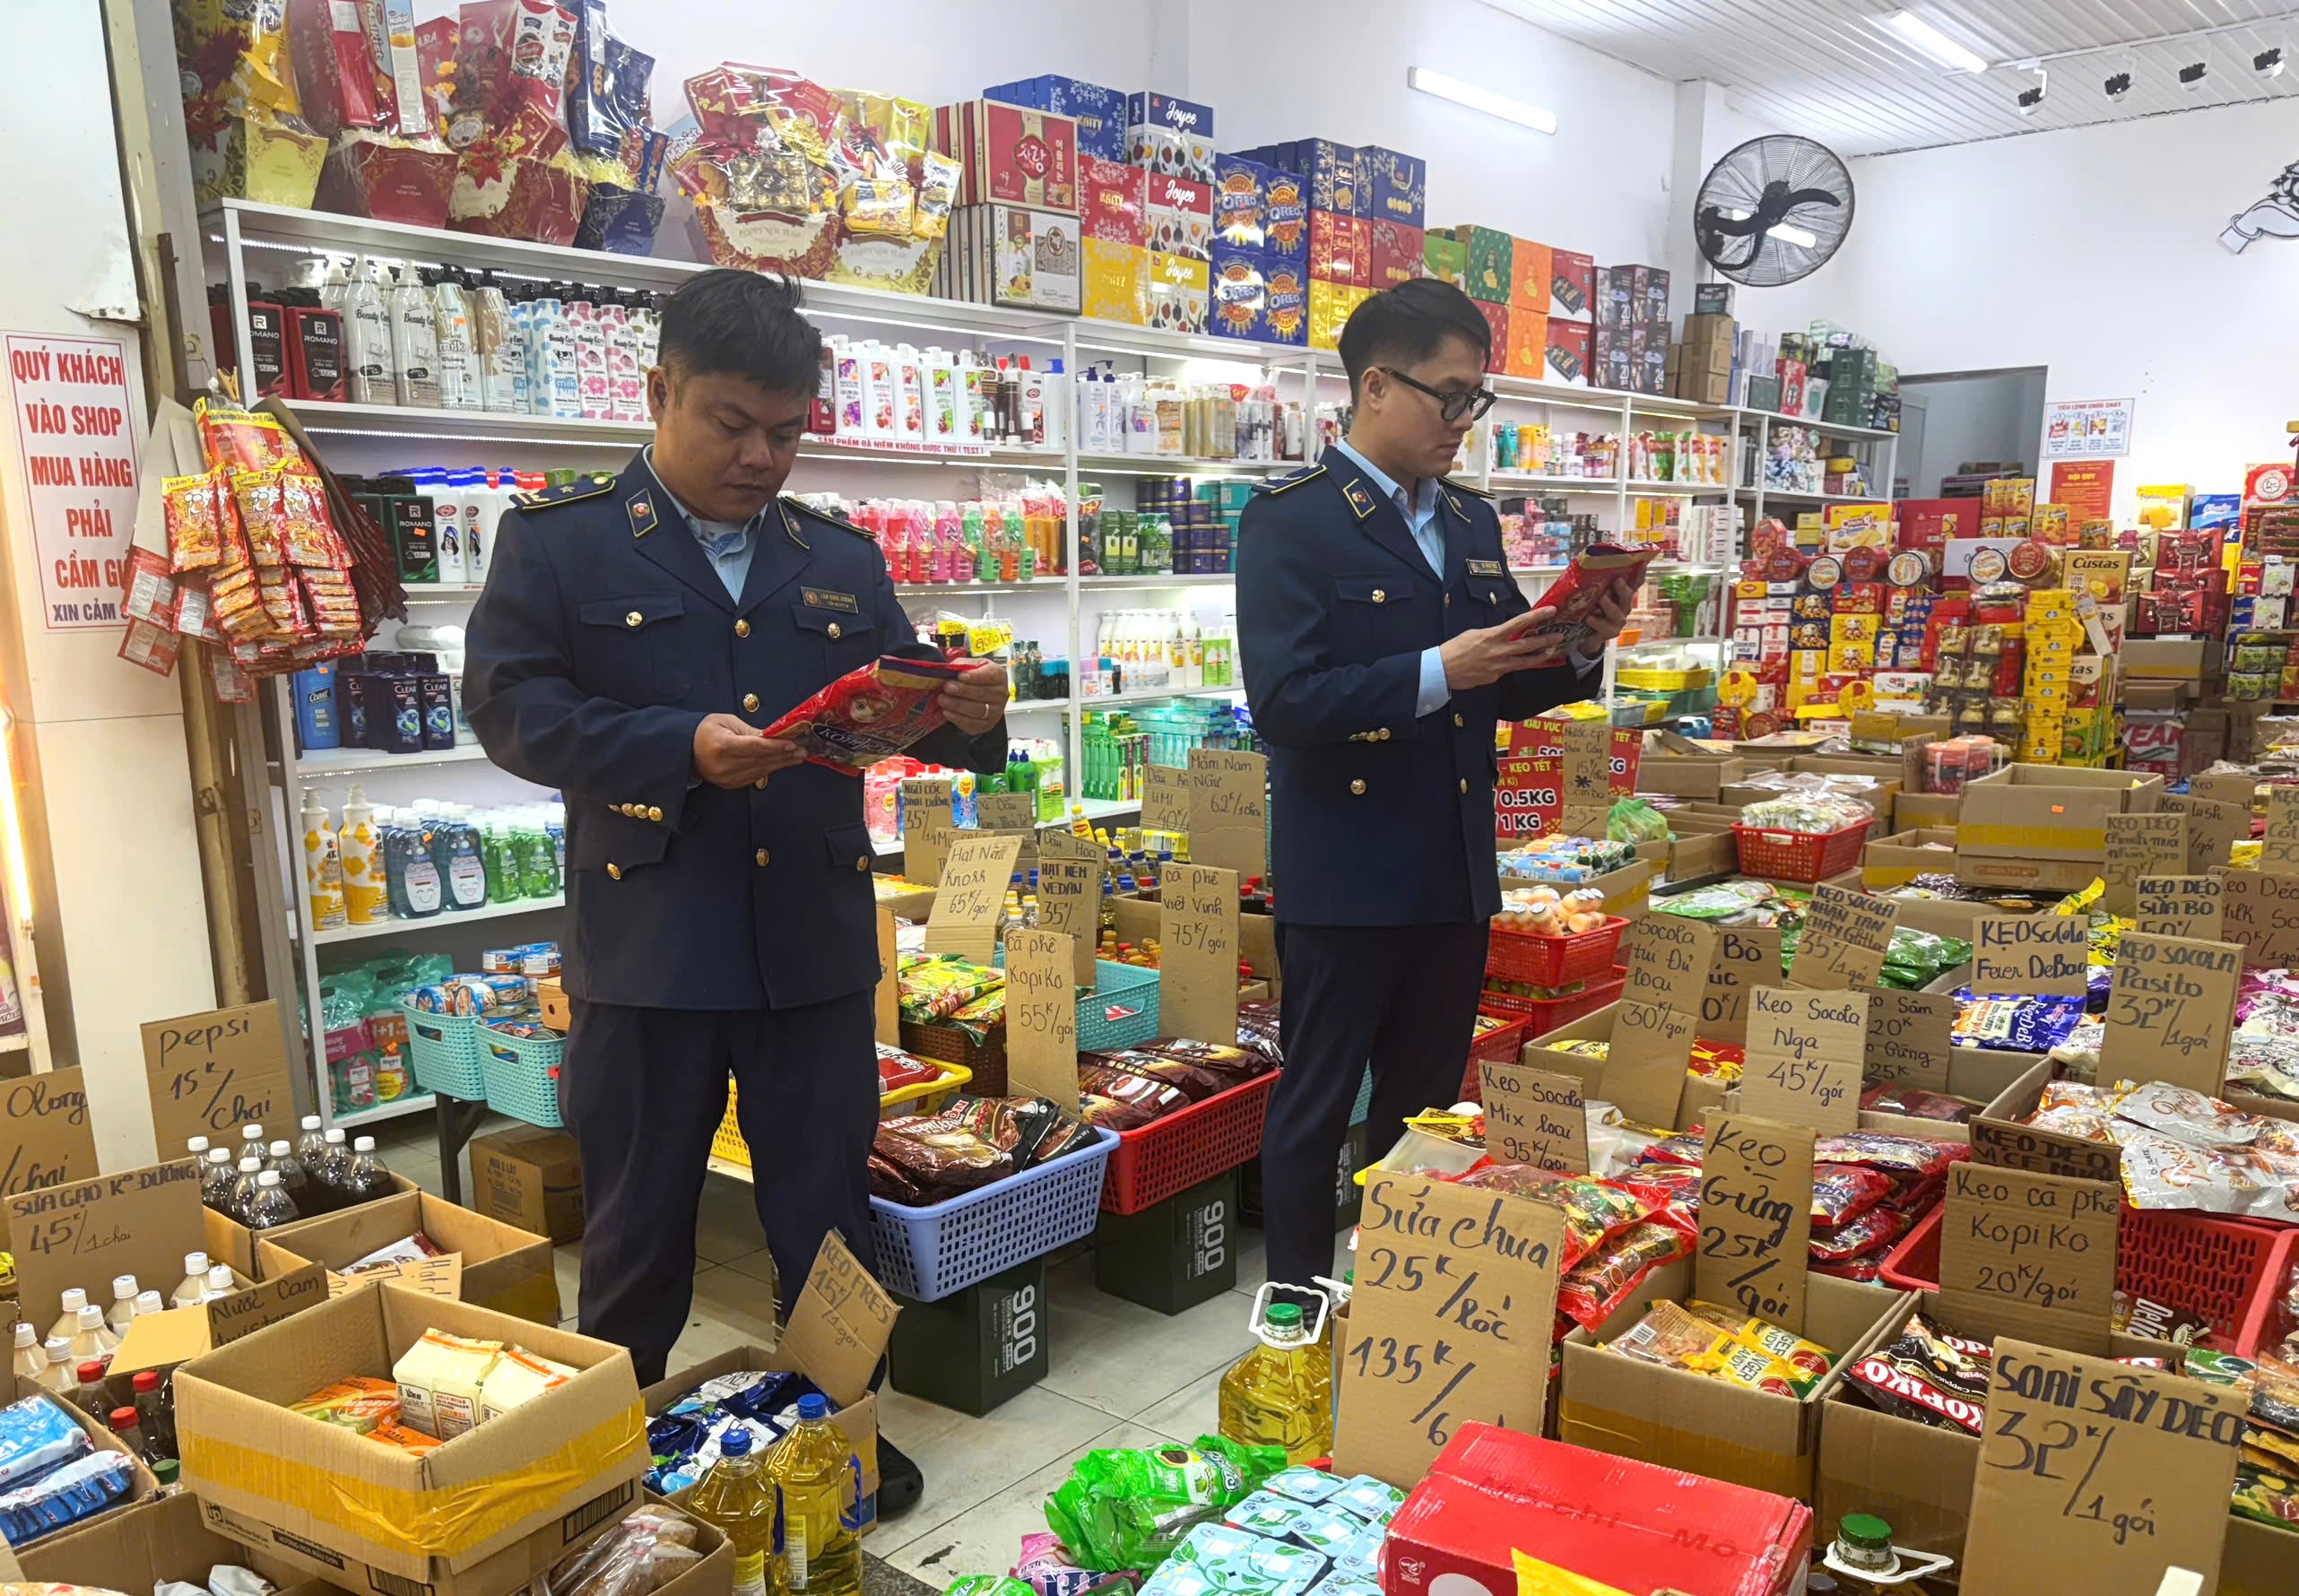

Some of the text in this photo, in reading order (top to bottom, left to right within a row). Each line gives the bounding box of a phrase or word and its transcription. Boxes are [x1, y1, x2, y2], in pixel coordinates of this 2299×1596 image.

[1166, 100, 1198, 126] Joyee
[1166, 179, 1196, 206] Joyee
[1221, 192, 1257, 212] OREO
[1270, 205, 1302, 221] OREO
[1166, 257, 1194, 282] Joyee
[1220, 284, 1256, 302] OREO
[1270, 292, 1301, 308] OREO
[304, 335, 338, 345] ROMANO
[438, 340, 465, 352] milk
[13, 345, 124, 386] QUÝ KHÁCH
[555, 377, 578, 390] milk
[25, 398, 122, 437] VÀO SHOP
[895, 440, 920, 452] KHÔNG
[963, 447, 979, 455] TEST
[30, 452, 134, 488] MUA HÀNG
[65, 499, 113, 537] PHẢI
[399, 520, 432, 528] ROMANO
[55, 550, 100, 588] CẦM
[2072, 556, 2120, 570] Custas
[53, 598, 117, 621] XIN CẢM
[394, 684, 416, 694] CLEAR
[424, 682, 447, 691] CLEAR
[1523, 719, 1541, 729] KHU
[1615, 731, 1631, 742] TẾT
[1191, 750, 1253, 771] Mắm Nam
[1509, 758, 1551, 775] KẸO TẾT
[924, 782, 941, 794] CỐC
[1500, 789, 1556, 806] 0.5KG
[1564, 782, 1605, 799] Combo
[951, 847, 974, 862] Hạt
[1043, 830, 1097, 858] Dầu Hoa
[1042, 863, 1060, 878] HẠT
[1193, 870, 1219, 886] phê
[1043, 882, 1082, 895] VEDAN
[1816, 883, 1896, 918] KẸO SOCOLA
[2139, 880, 2174, 899] KẸO
[1193, 898, 1222, 916] Vinh
[1809, 900, 1886, 933] NHÂN TAN
[2186, 896, 2215, 916] BÒ
[1636, 915, 1696, 945] Socola
[1981, 920, 2031, 951] KẸO
[1029, 935, 1056, 954] phê
[1722, 933, 1762, 961] Bò
[1667, 949, 1694, 973] Đủ
[2119, 941, 2236, 974] KẸO SOCOLA
[2118, 965, 2204, 998] Pasito
[1756, 990, 1861, 1026] Kẹo Socola
[1898, 996, 1933, 1015] Sâm
[1773, 1028, 1818, 1059] Nga
[1886, 1042, 1938, 1070] Gừng
[1481, 1065, 1584, 1109] Kẹo Socola
[7, 1080, 88, 1125] Olong
[1488, 1101, 1571, 1145] Mix loại
[1708, 1120, 1787, 1173] Kẹo
[1974, 1126, 2036, 1156] KẸO
[13, 1191, 57, 1220] SỮA
[59, 1184, 102, 1214] GẠO
[1956, 1170, 2009, 1206] Kẹo
[2072, 1188, 2118, 1220] phê
[1203, 1200, 1225, 1271] 900
[821, 1237, 894, 1325] KẸO FRES
[211, 1275, 320, 1324] Nước Cam
[1012, 1284, 1037, 1366] 900
[2156, 1392, 2246, 1447] DẺO
